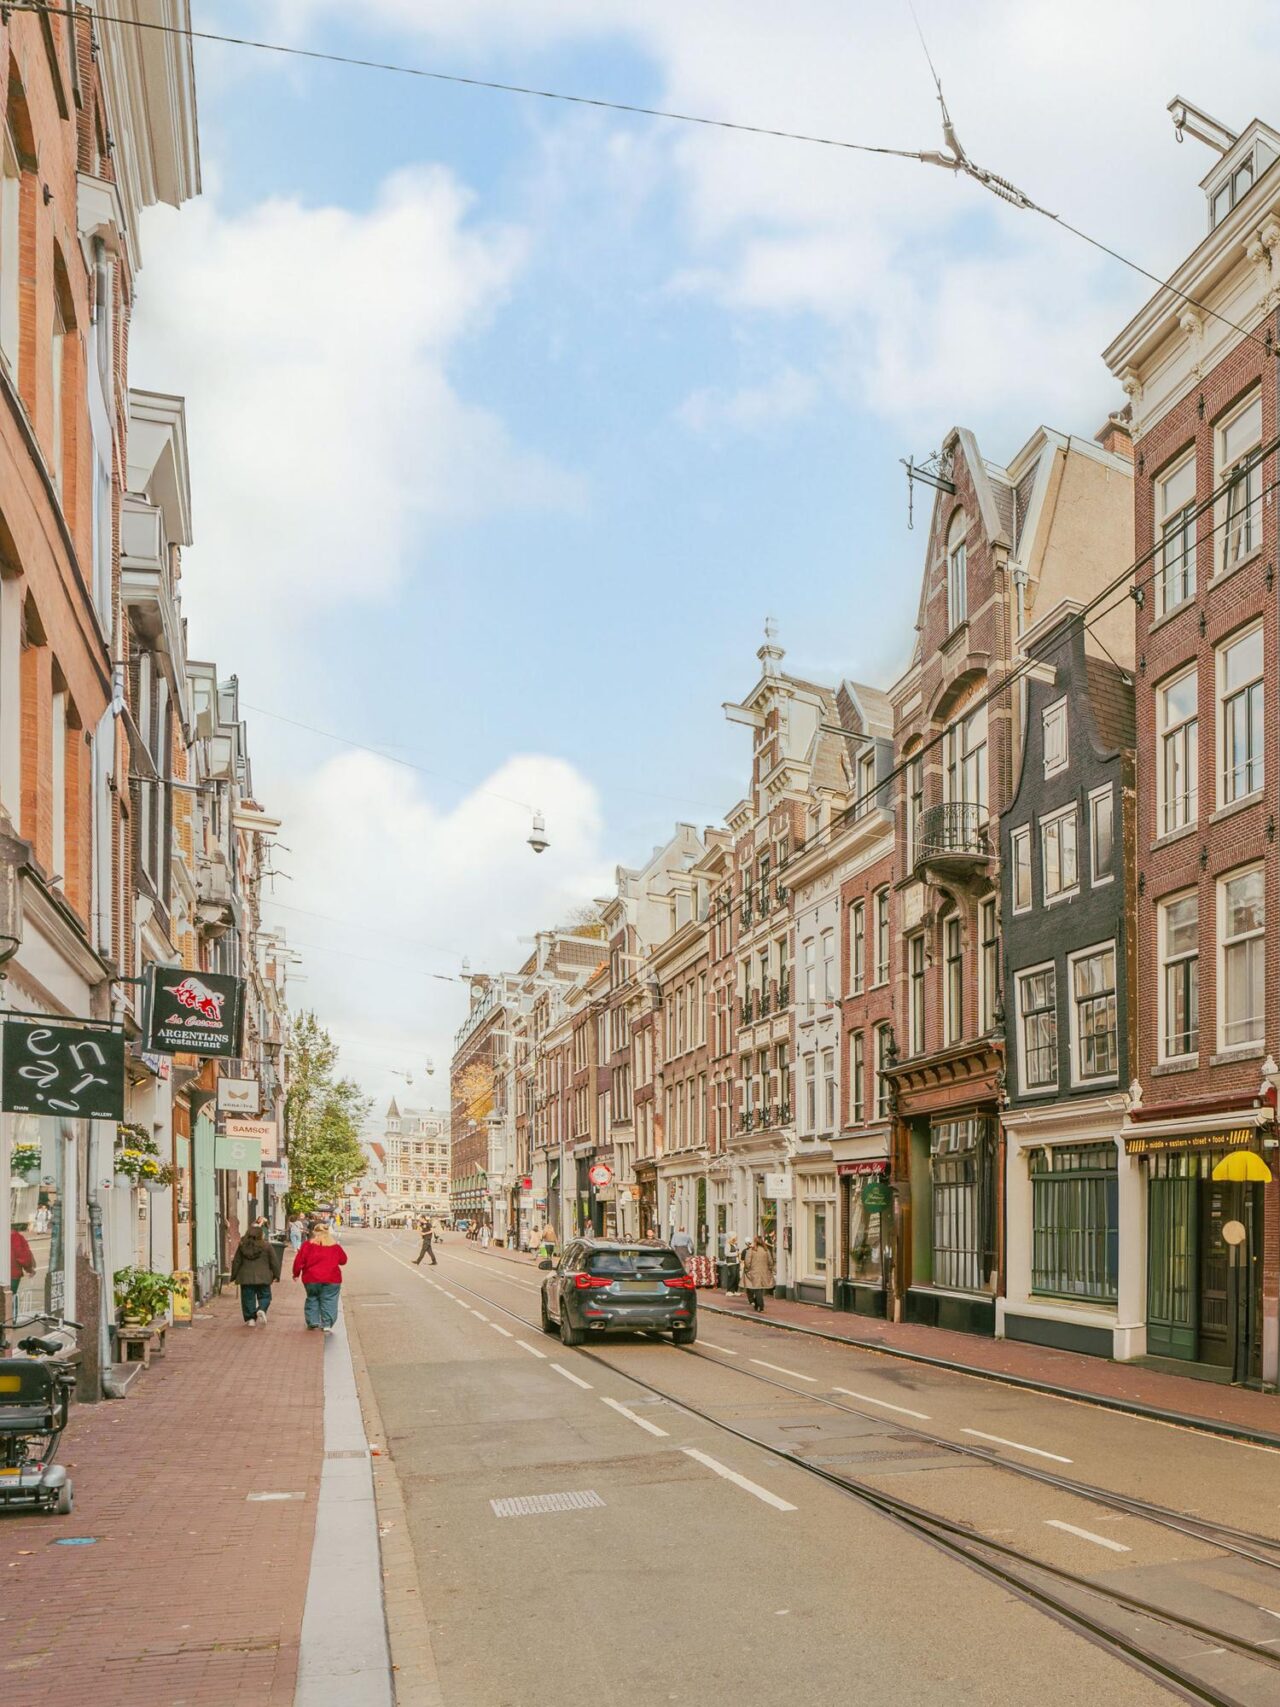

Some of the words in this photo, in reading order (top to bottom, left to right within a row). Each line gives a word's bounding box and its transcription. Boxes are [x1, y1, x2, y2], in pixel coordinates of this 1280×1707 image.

[158, 1028, 229, 1043] ARGENTIJNS
[165, 1037, 221, 1049] restaurant
[1149, 1141, 1164, 1149] middle
[1169, 1139, 1188, 1148] eastern
[1192, 1137, 1207, 1146] street
[1212, 1135, 1225, 1144] food
